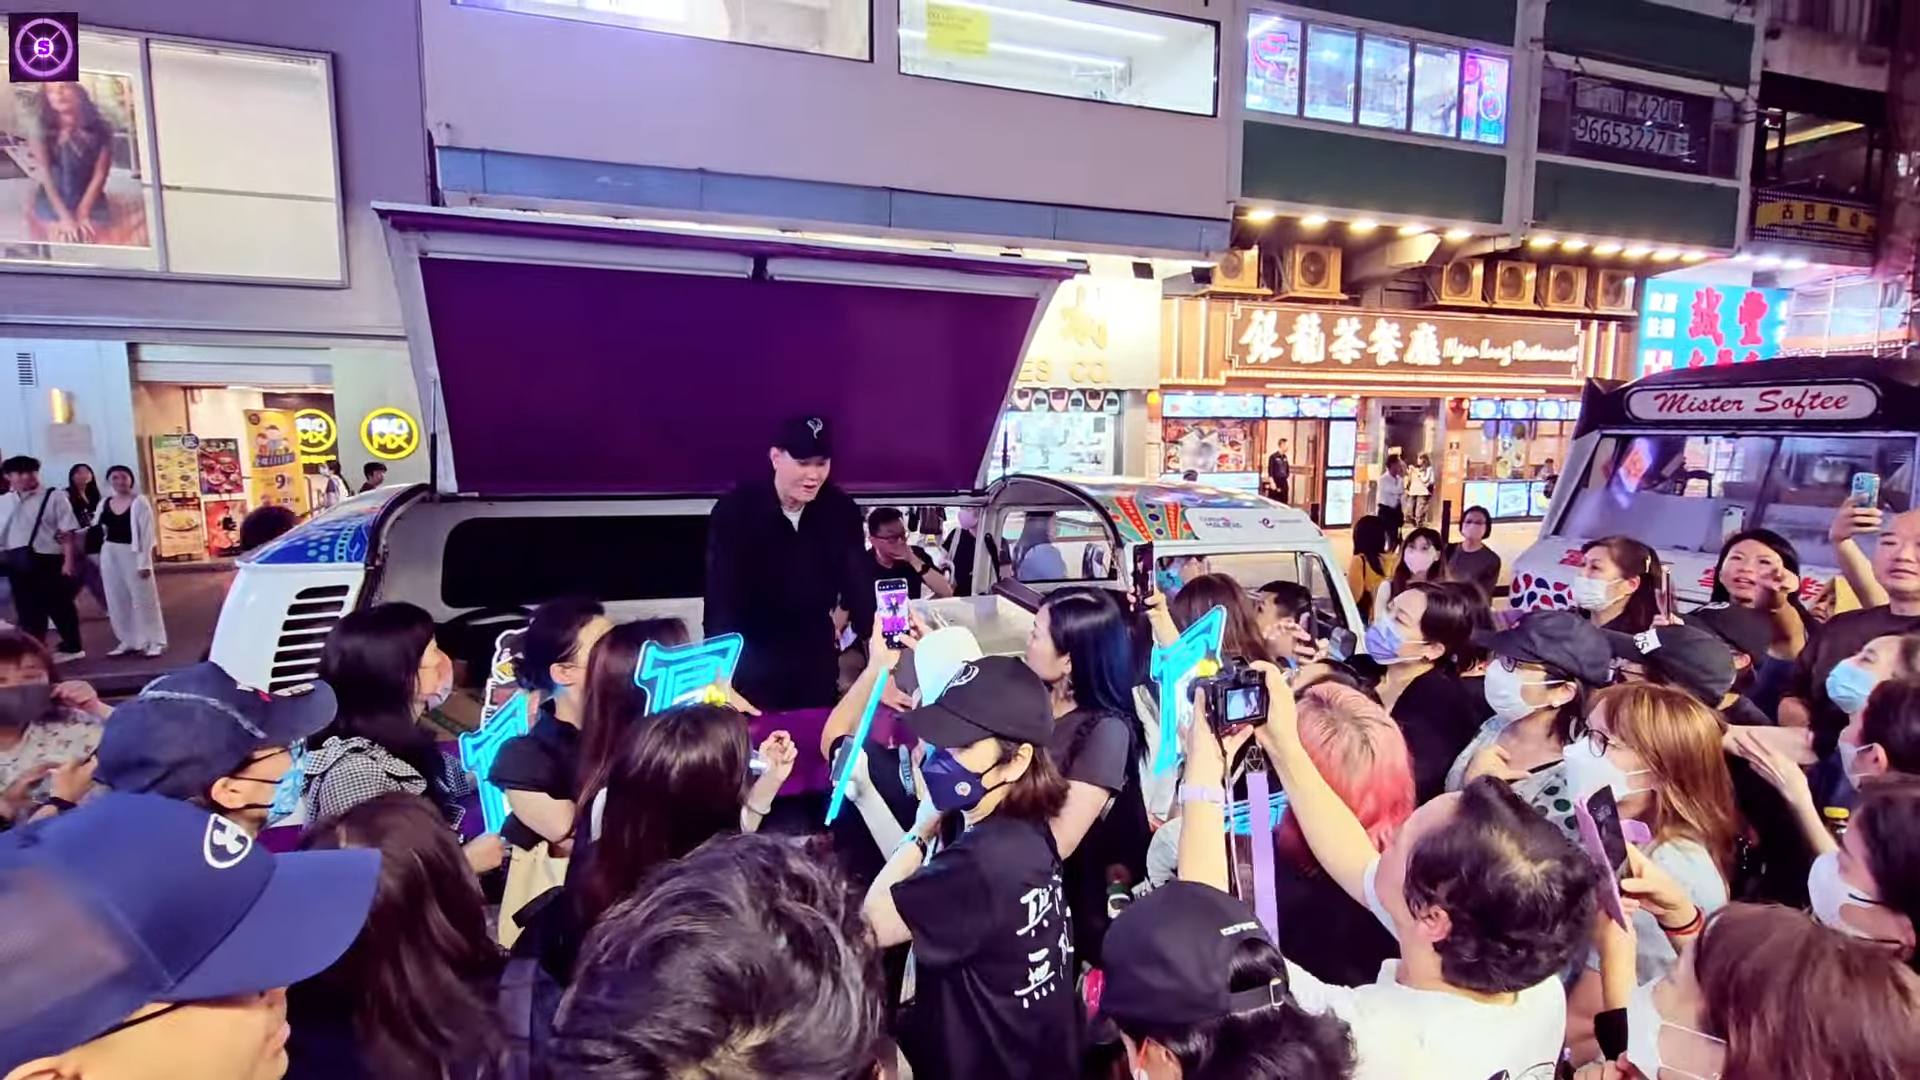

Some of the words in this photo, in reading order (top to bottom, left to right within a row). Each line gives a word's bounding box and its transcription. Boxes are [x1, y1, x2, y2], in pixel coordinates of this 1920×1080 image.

[1240, 309, 1442, 367] 銀龍茶餐廳
[1654, 392, 1744, 414] Mister
[1754, 388, 1849, 418] Softee
